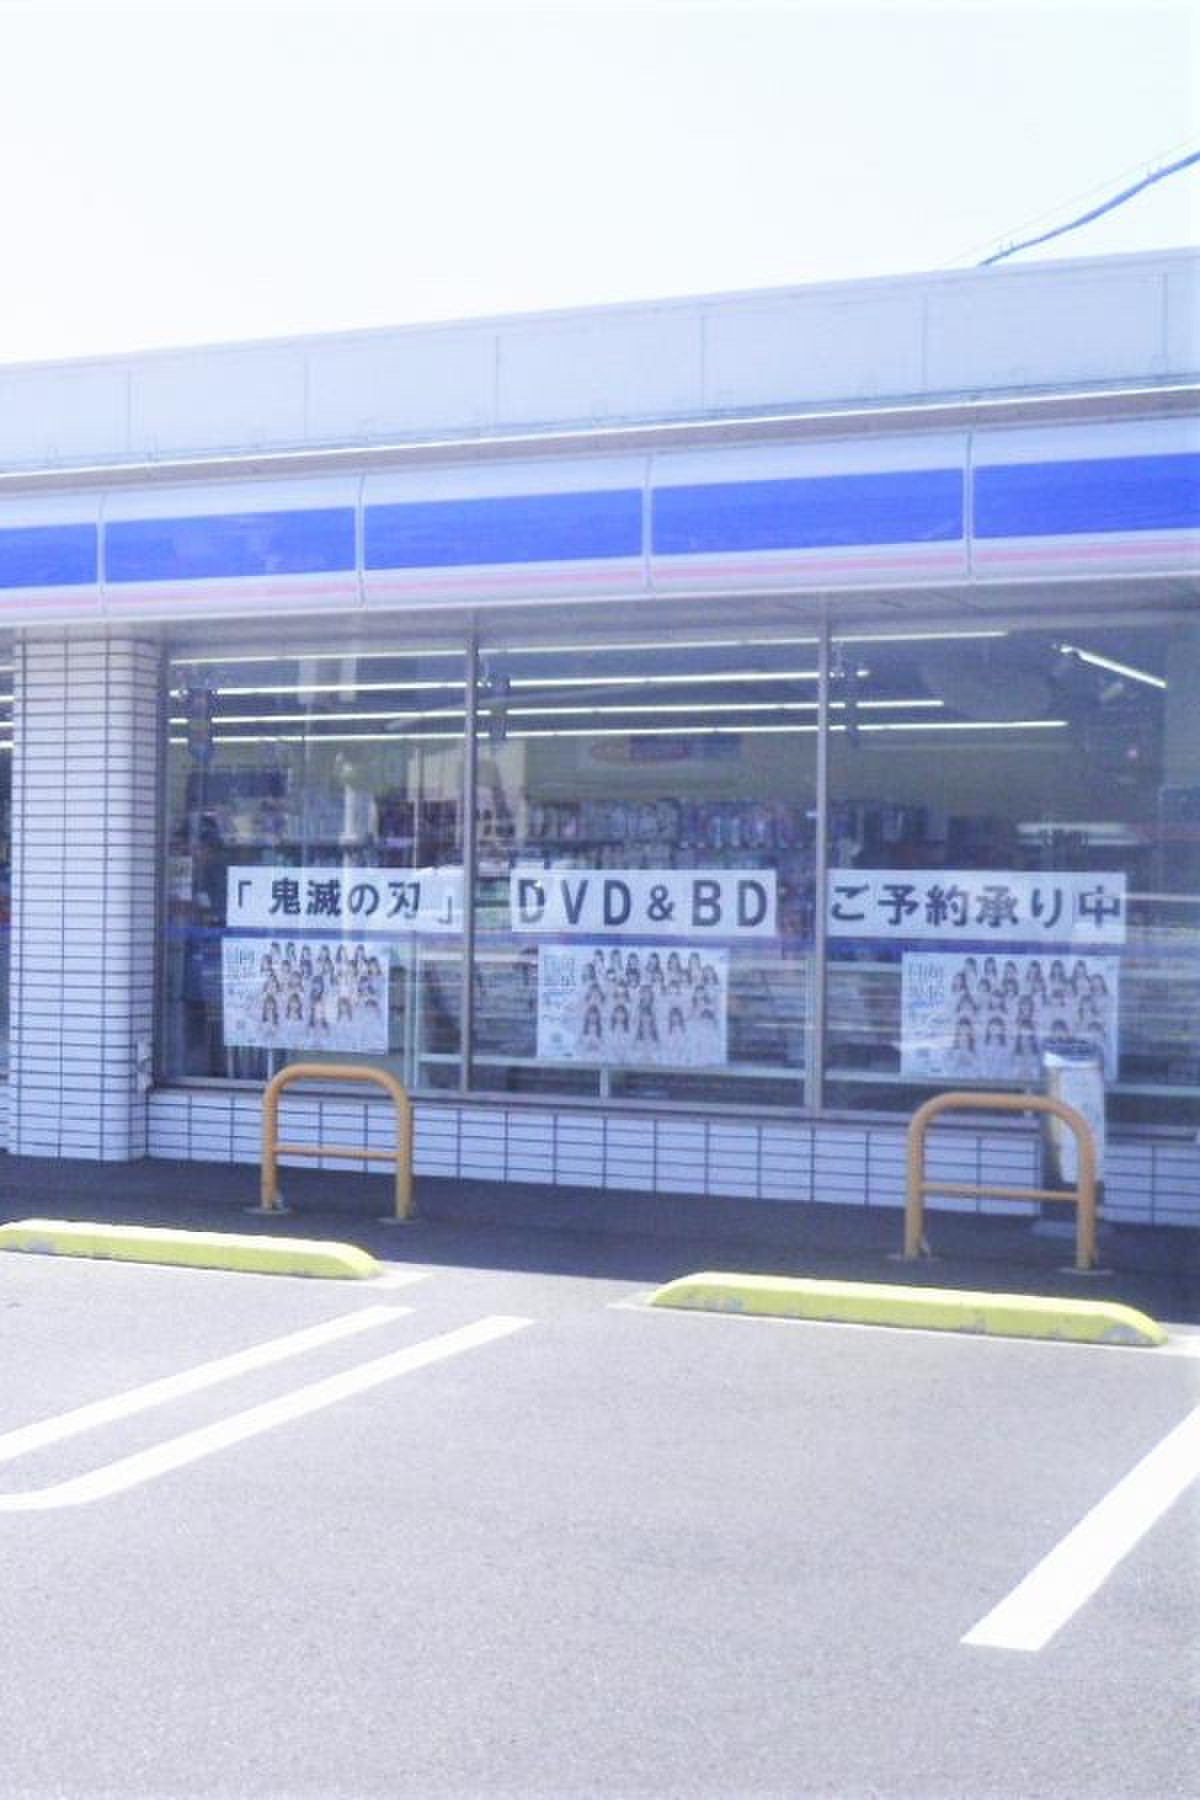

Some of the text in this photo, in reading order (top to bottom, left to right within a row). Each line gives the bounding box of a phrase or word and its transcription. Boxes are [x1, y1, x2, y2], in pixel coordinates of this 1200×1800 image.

[831, 884, 1120, 928] ご予約承り中
